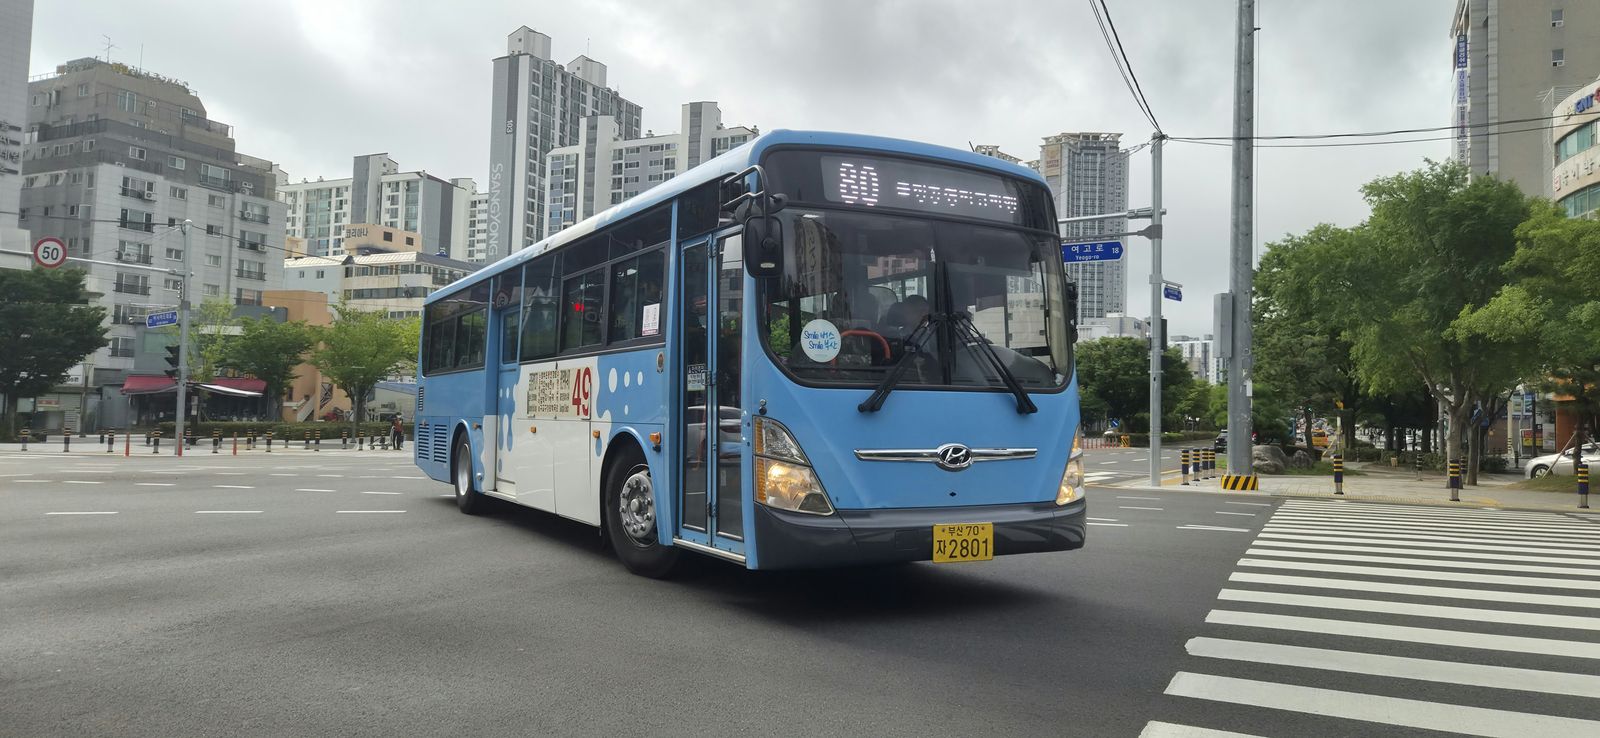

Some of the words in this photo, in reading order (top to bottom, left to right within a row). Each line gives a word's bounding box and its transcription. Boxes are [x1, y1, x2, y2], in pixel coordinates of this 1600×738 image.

[506, 120, 514, 133] 103
[839, 163, 879, 207] 80
[488, 163, 504, 256] SSANGYONG
[345, 227, 369, 239] 코리아나
[42, 246, 59, 260] 50
[1071, 244, 1104, 254] 여고로
[804, 330, 819, 340] Smile
[820, 330, 835, 340] 버스
[808, 340, 824, 350] Smile
[824, 339, 838, 351] 부산
[572, 367, 592, 416] 49
[948, 525, 963, 537] 부산
[965, 525, 979, 536] 70
[936, 538, 988, 559] 자2801
